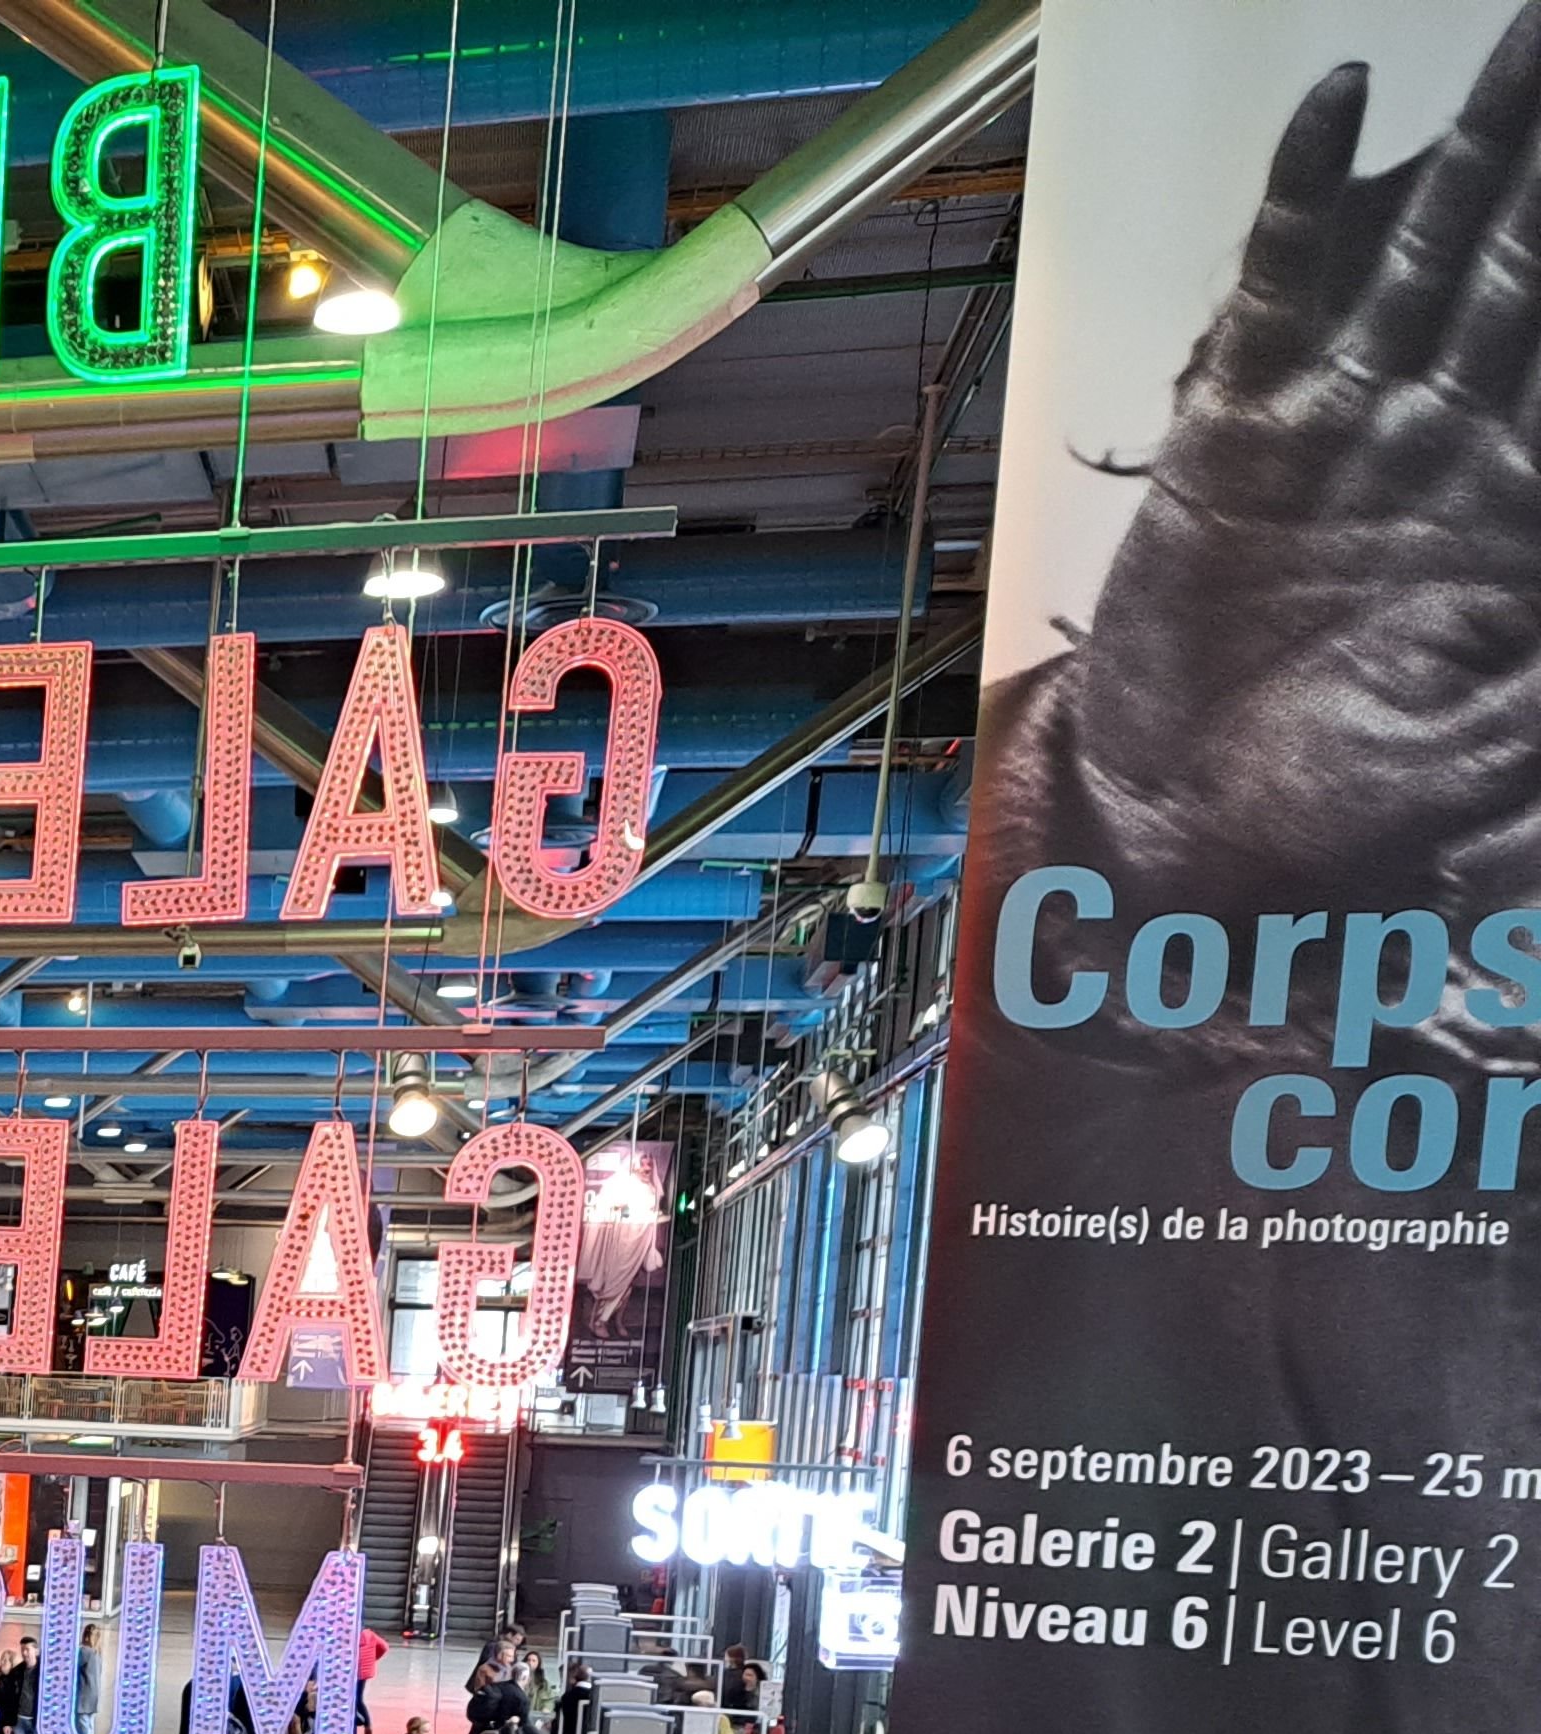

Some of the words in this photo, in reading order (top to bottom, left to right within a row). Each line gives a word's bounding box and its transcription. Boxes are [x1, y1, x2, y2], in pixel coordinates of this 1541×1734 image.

[993, 865, 1541, 1069] Corps
[971, 1203, 1151, 1245] Histoire(s)
[1163, 1206, 1205, 1241] de
[1219, 1208, 1248, 1241] la
[1260, 1209, 1510, 1251] photographie
[109, 1259, 147, 1283] CAFÉ
[946, 1435, 973, 1475] 6
[988, 1440, 1233, 1491] septembre
[1250, 1447, 1372, 1491] 2023
[1423, 1453, 1484, 1497] 25
[938, 1509, 1157, 1575] Galerie
[1176, 1520, 1216, 1574] 2
[1258, 1524, 1465, 1598] Gallery
[1482, 1534, 1520, 1588] 2
[932, 1583, 1147, 1646] Niveau
[1170, 1596, 1210, 1650] 6
[1253, 1602, 1399, 1662] Level
[1423, 1609, 1458, 1664] 6
